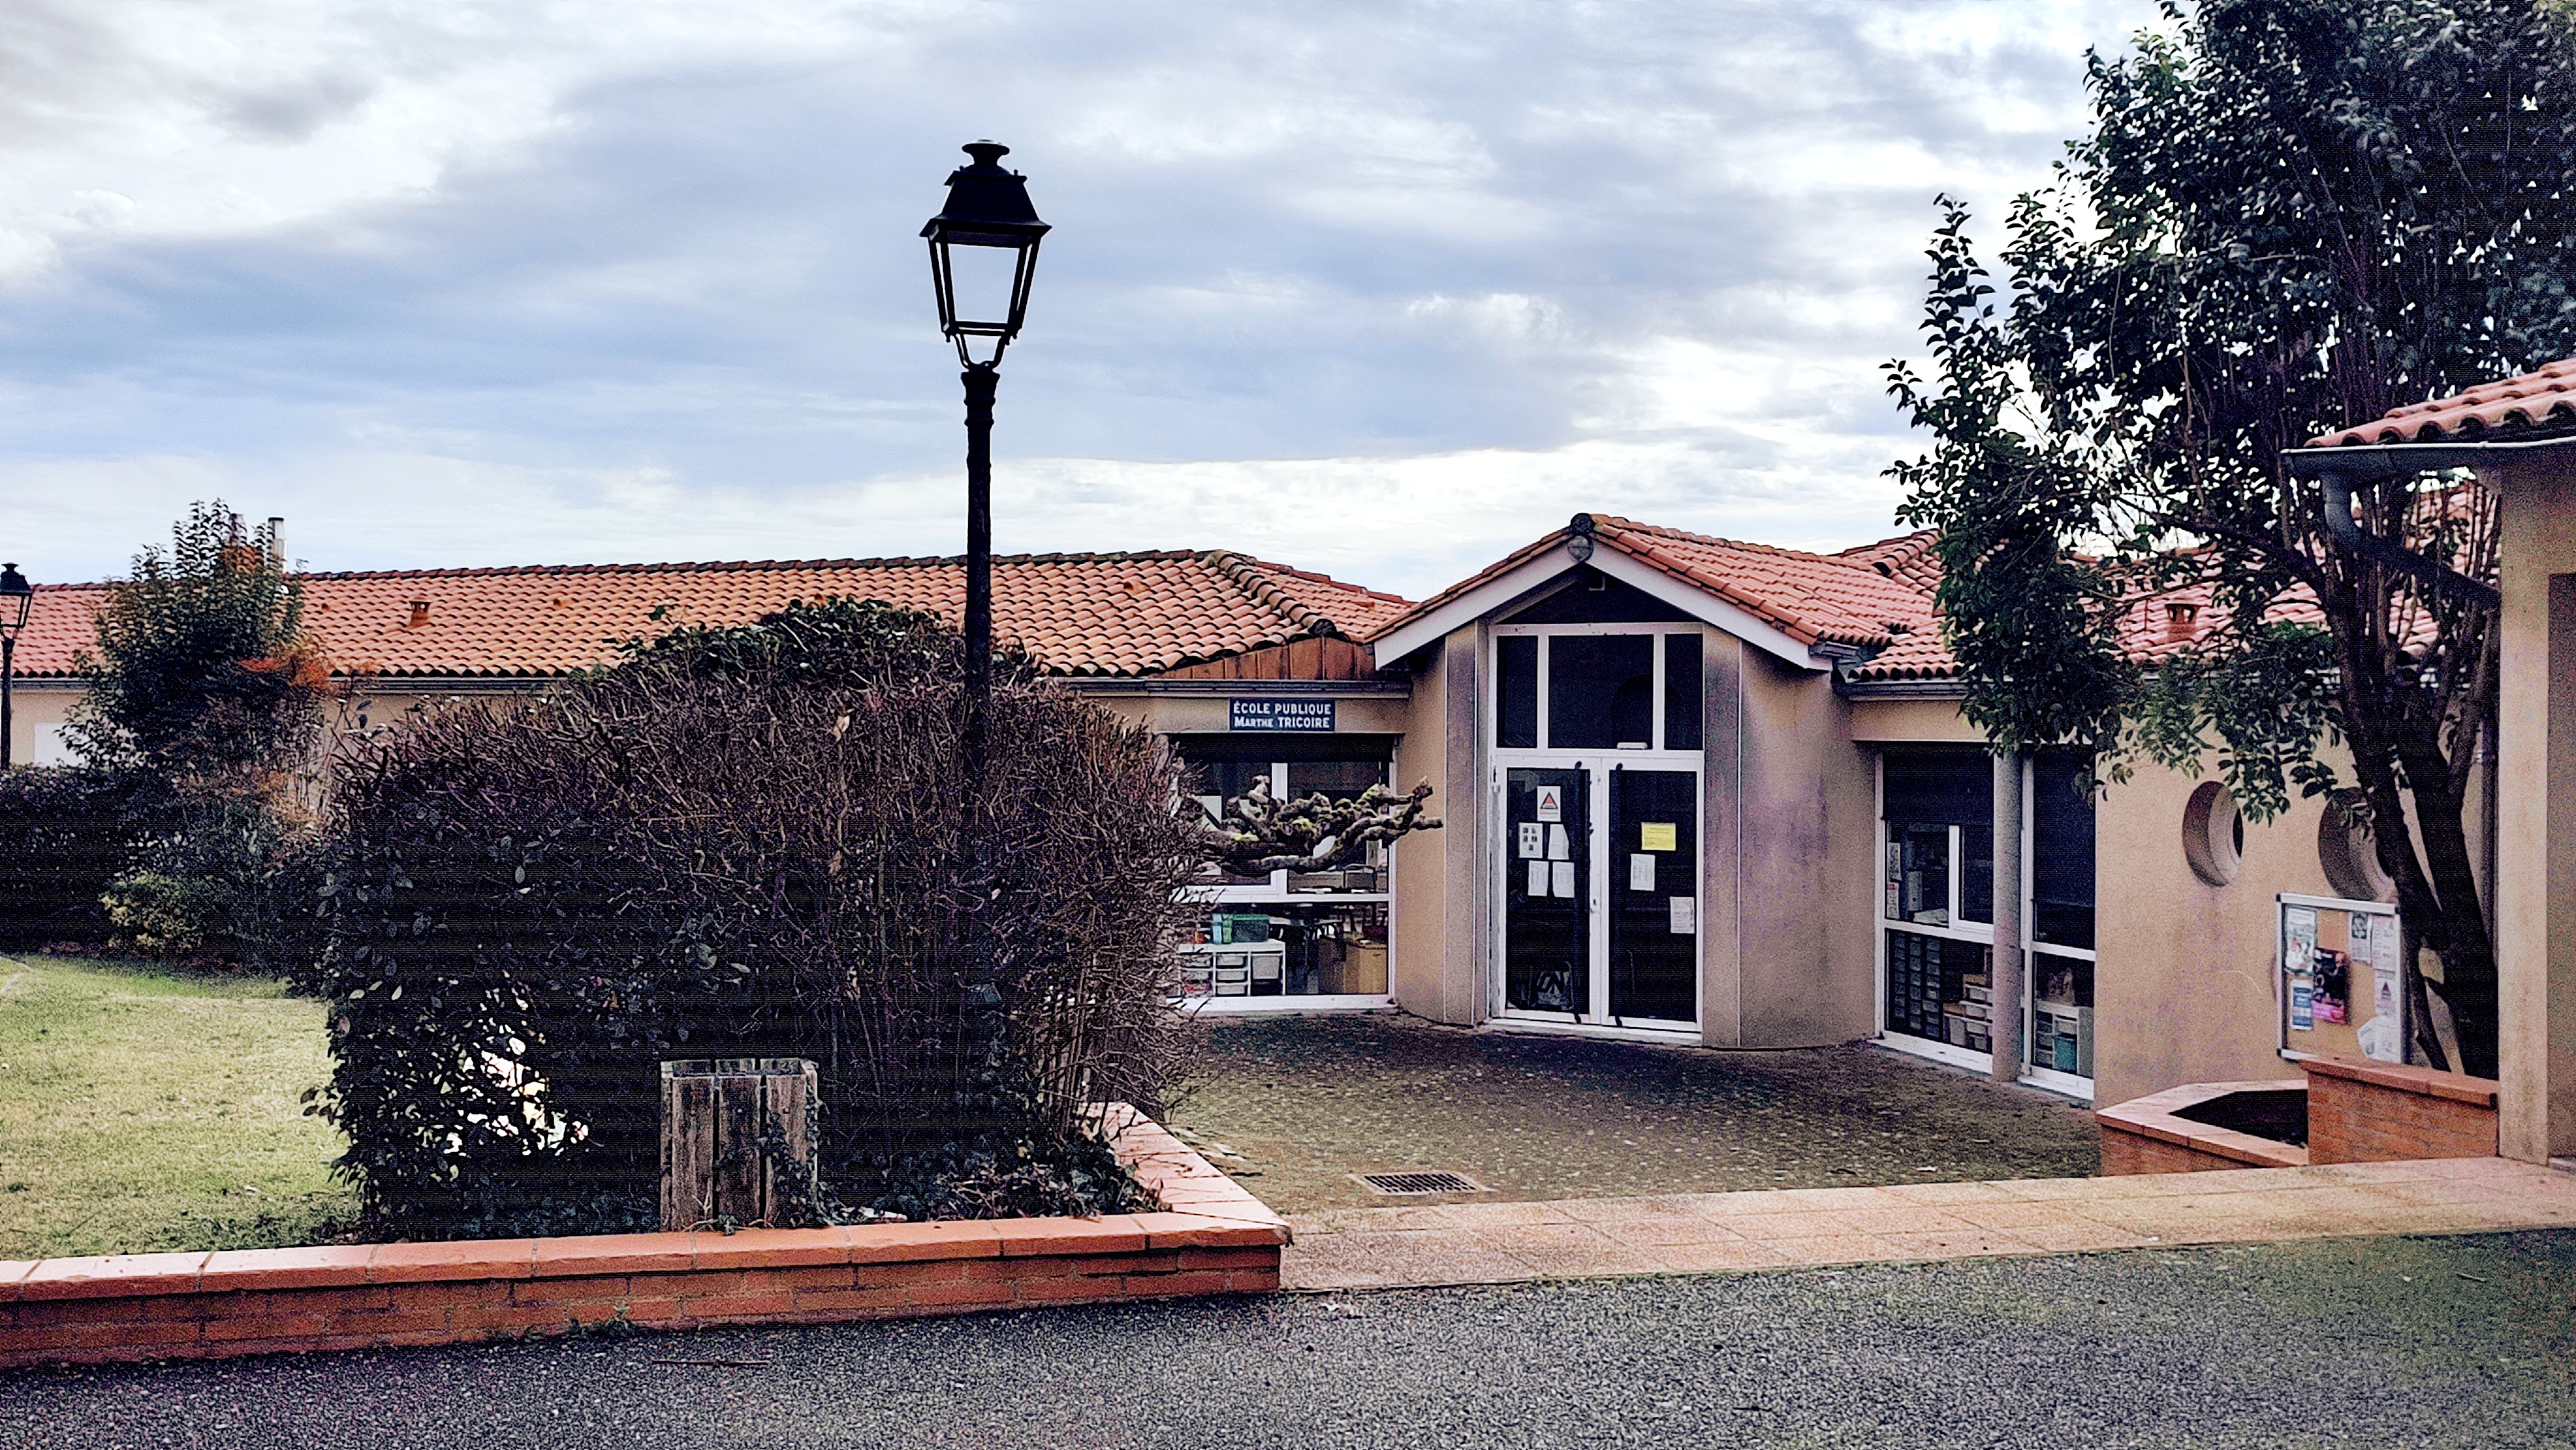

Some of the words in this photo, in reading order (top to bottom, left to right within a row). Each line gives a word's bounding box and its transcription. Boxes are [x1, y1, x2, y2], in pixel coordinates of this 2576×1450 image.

[1233, 701, 1271, 714] ÉCOLE
[1274, 703, 1331, 715] PUBLIQUE
[1277, 716, 1330, 728] TRICOIRE
